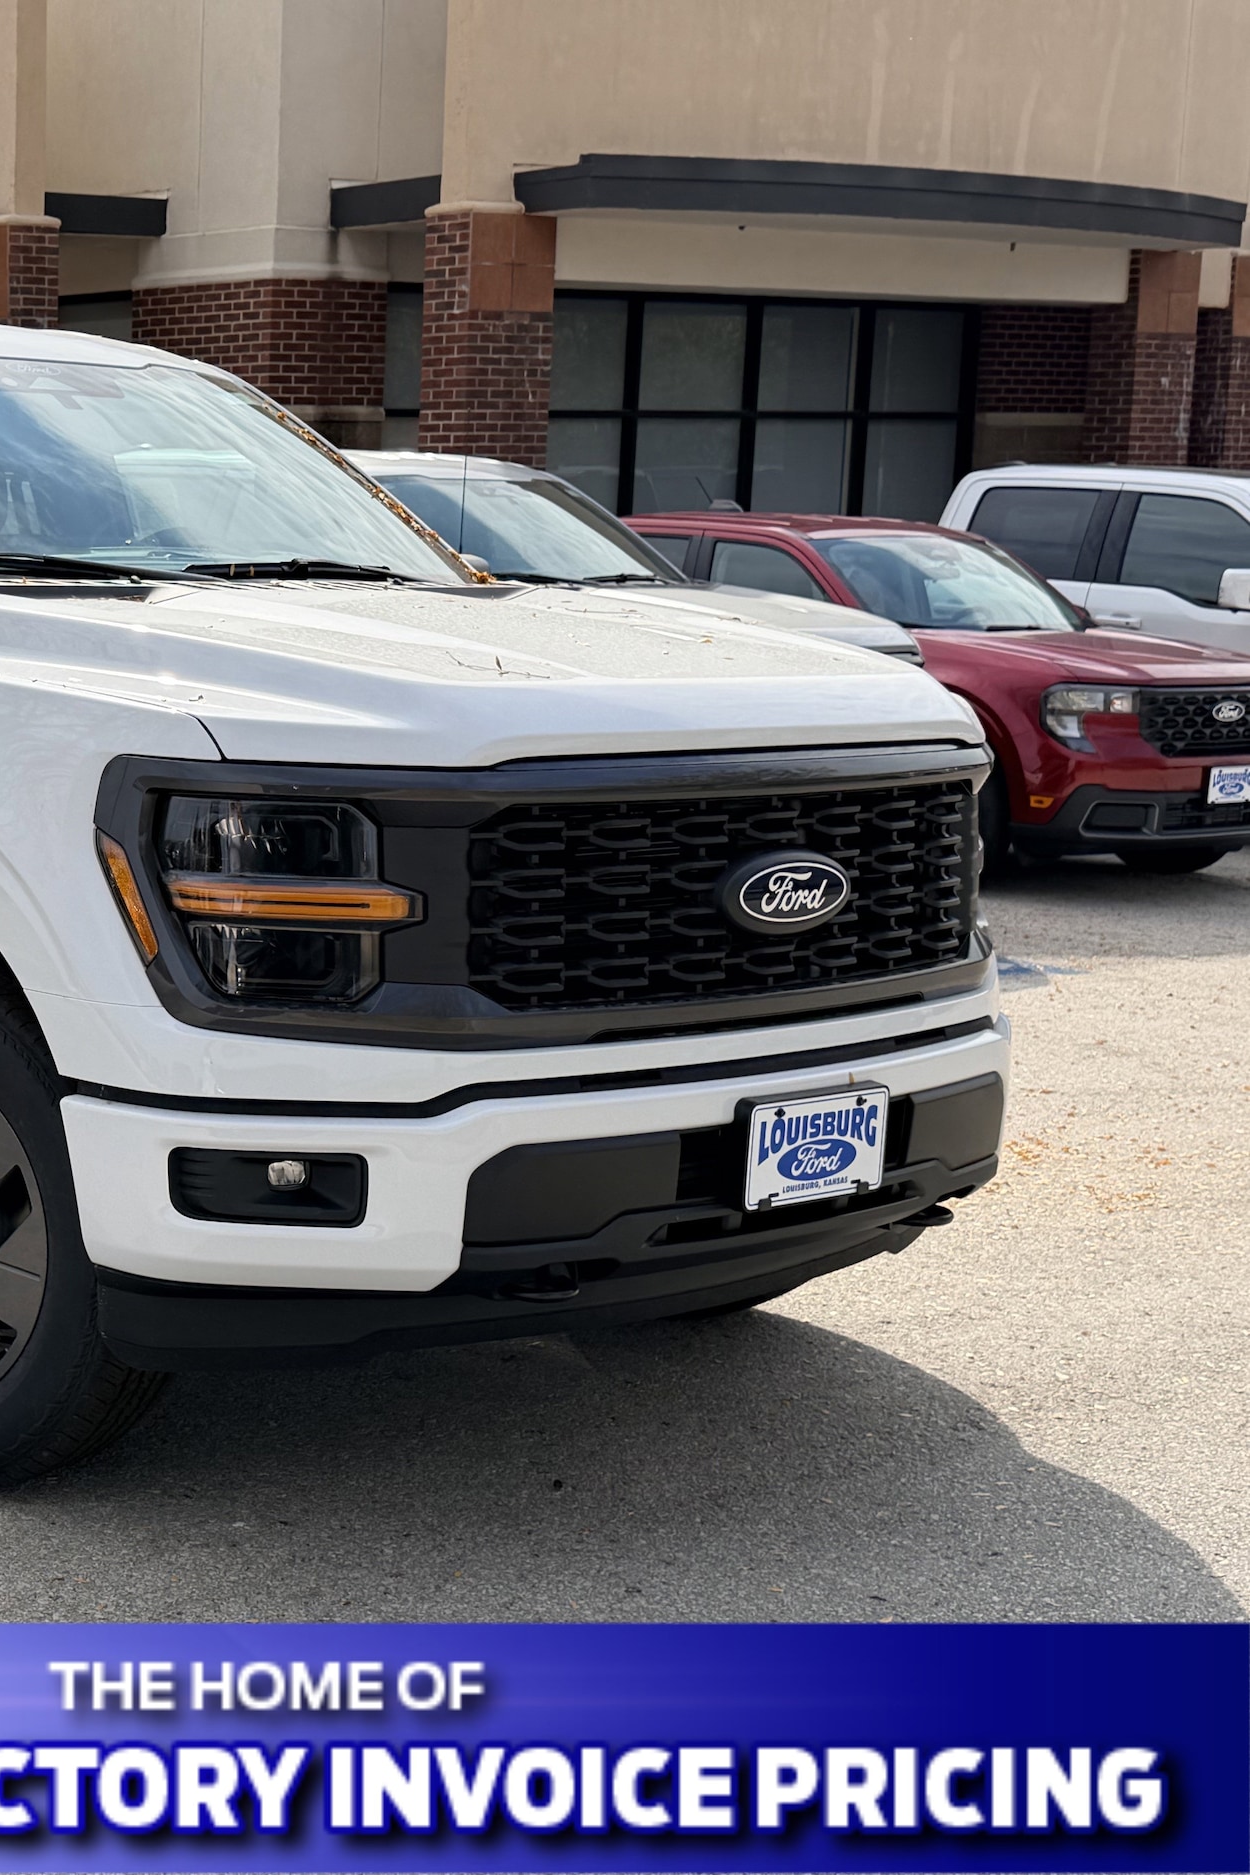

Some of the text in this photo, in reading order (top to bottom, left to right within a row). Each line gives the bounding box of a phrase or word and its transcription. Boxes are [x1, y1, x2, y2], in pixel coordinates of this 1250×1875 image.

[761, 871, 828, 913] Ford
[757, 1105, 878, 1166] LOUISBURG
[790, 1142, 843, 1176] Ford
